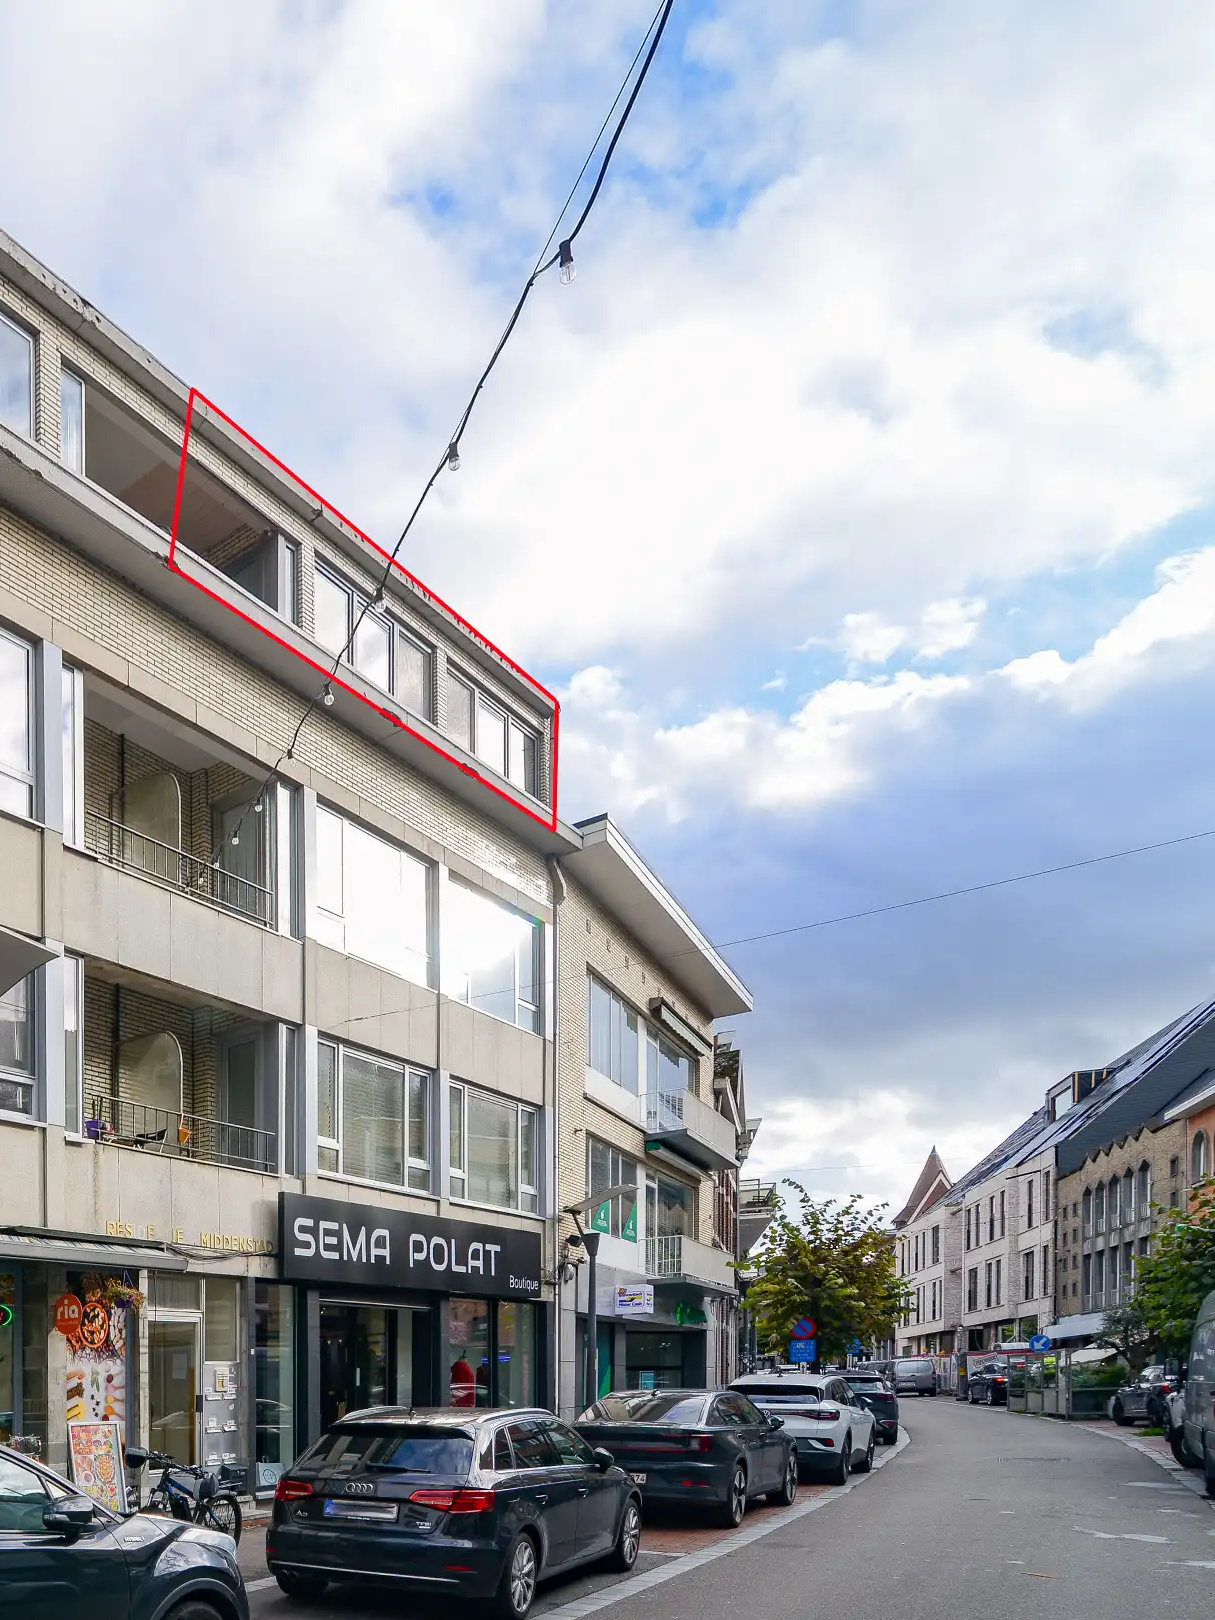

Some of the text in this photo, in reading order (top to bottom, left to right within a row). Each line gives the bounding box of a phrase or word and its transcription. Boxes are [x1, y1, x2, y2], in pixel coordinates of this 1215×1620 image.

[293, 1217, 501, 1276] SEMA POLAT
[509, 1275, 539, 1293] Boutique
[57, 1299, 79, 1320] ria
